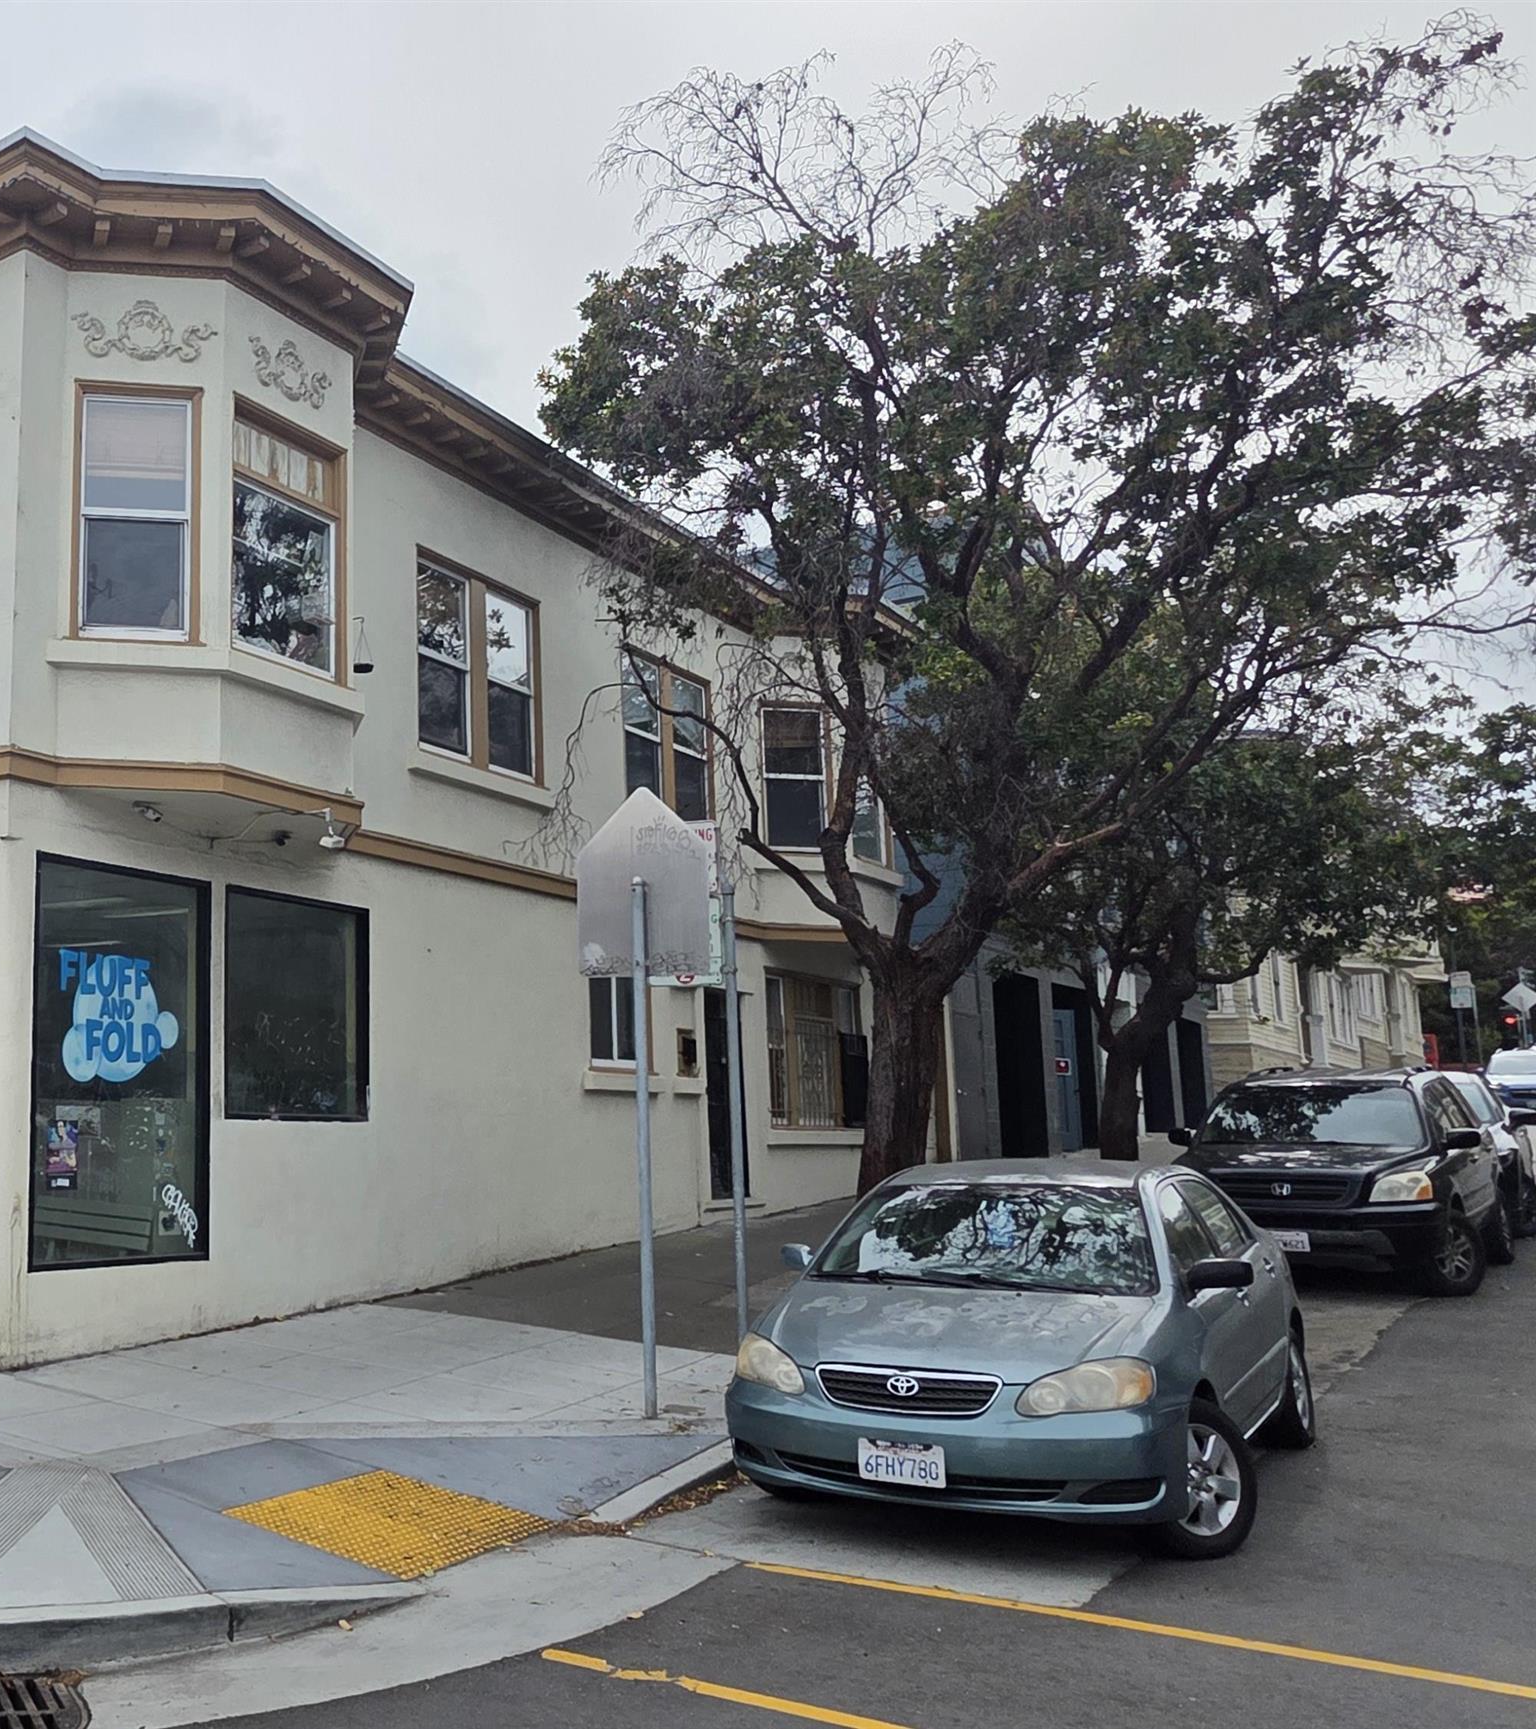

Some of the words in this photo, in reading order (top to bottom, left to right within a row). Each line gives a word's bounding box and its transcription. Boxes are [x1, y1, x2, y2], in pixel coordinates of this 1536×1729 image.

[59, 948, 150, 1000] FLUFF
[100, 997, 134, 1020] AND
[85, 1018, 162, 1064] FOLD
